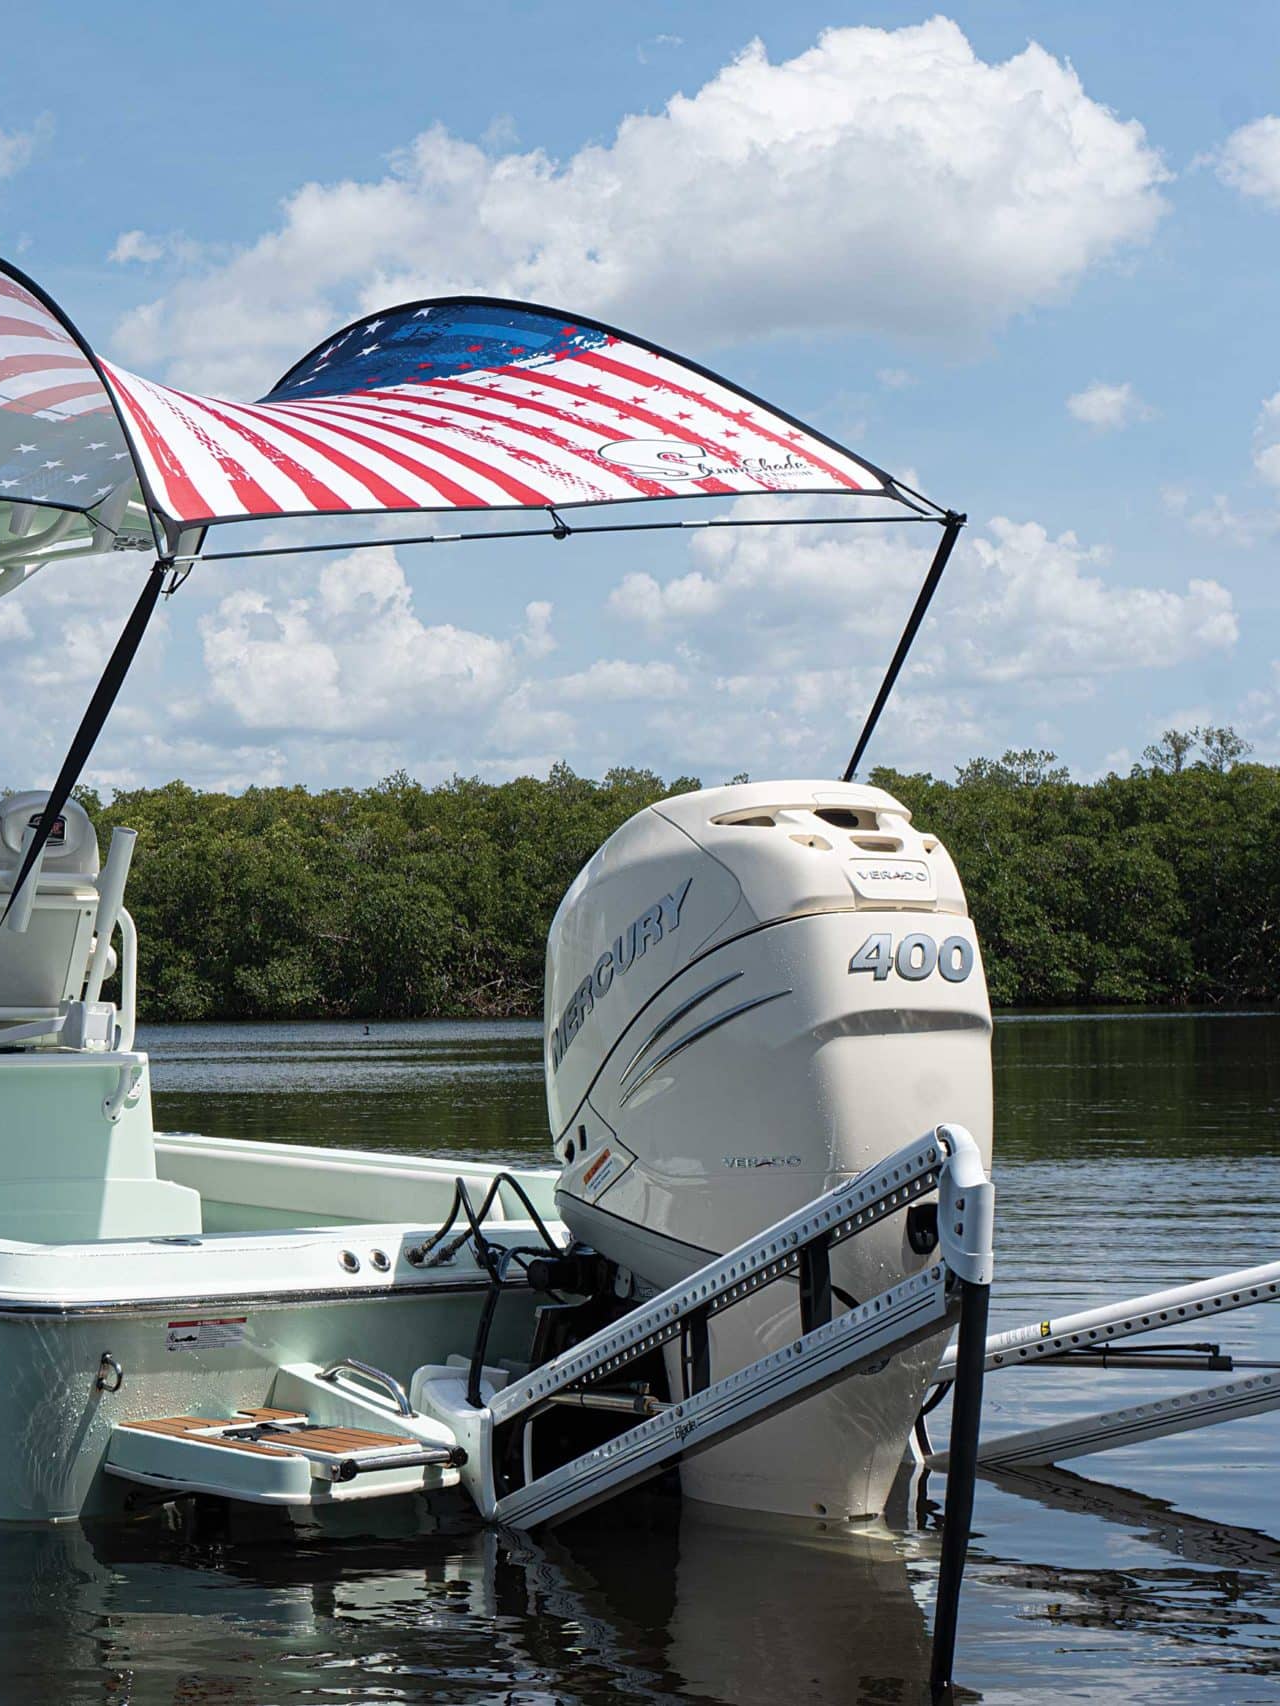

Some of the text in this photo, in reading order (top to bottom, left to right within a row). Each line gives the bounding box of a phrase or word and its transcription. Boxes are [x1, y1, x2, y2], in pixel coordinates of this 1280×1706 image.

[857, 870, 927, 882] VERADO
[550, 877, 693, 1074] MERCURY
[848, 932, 974, 983] 400
